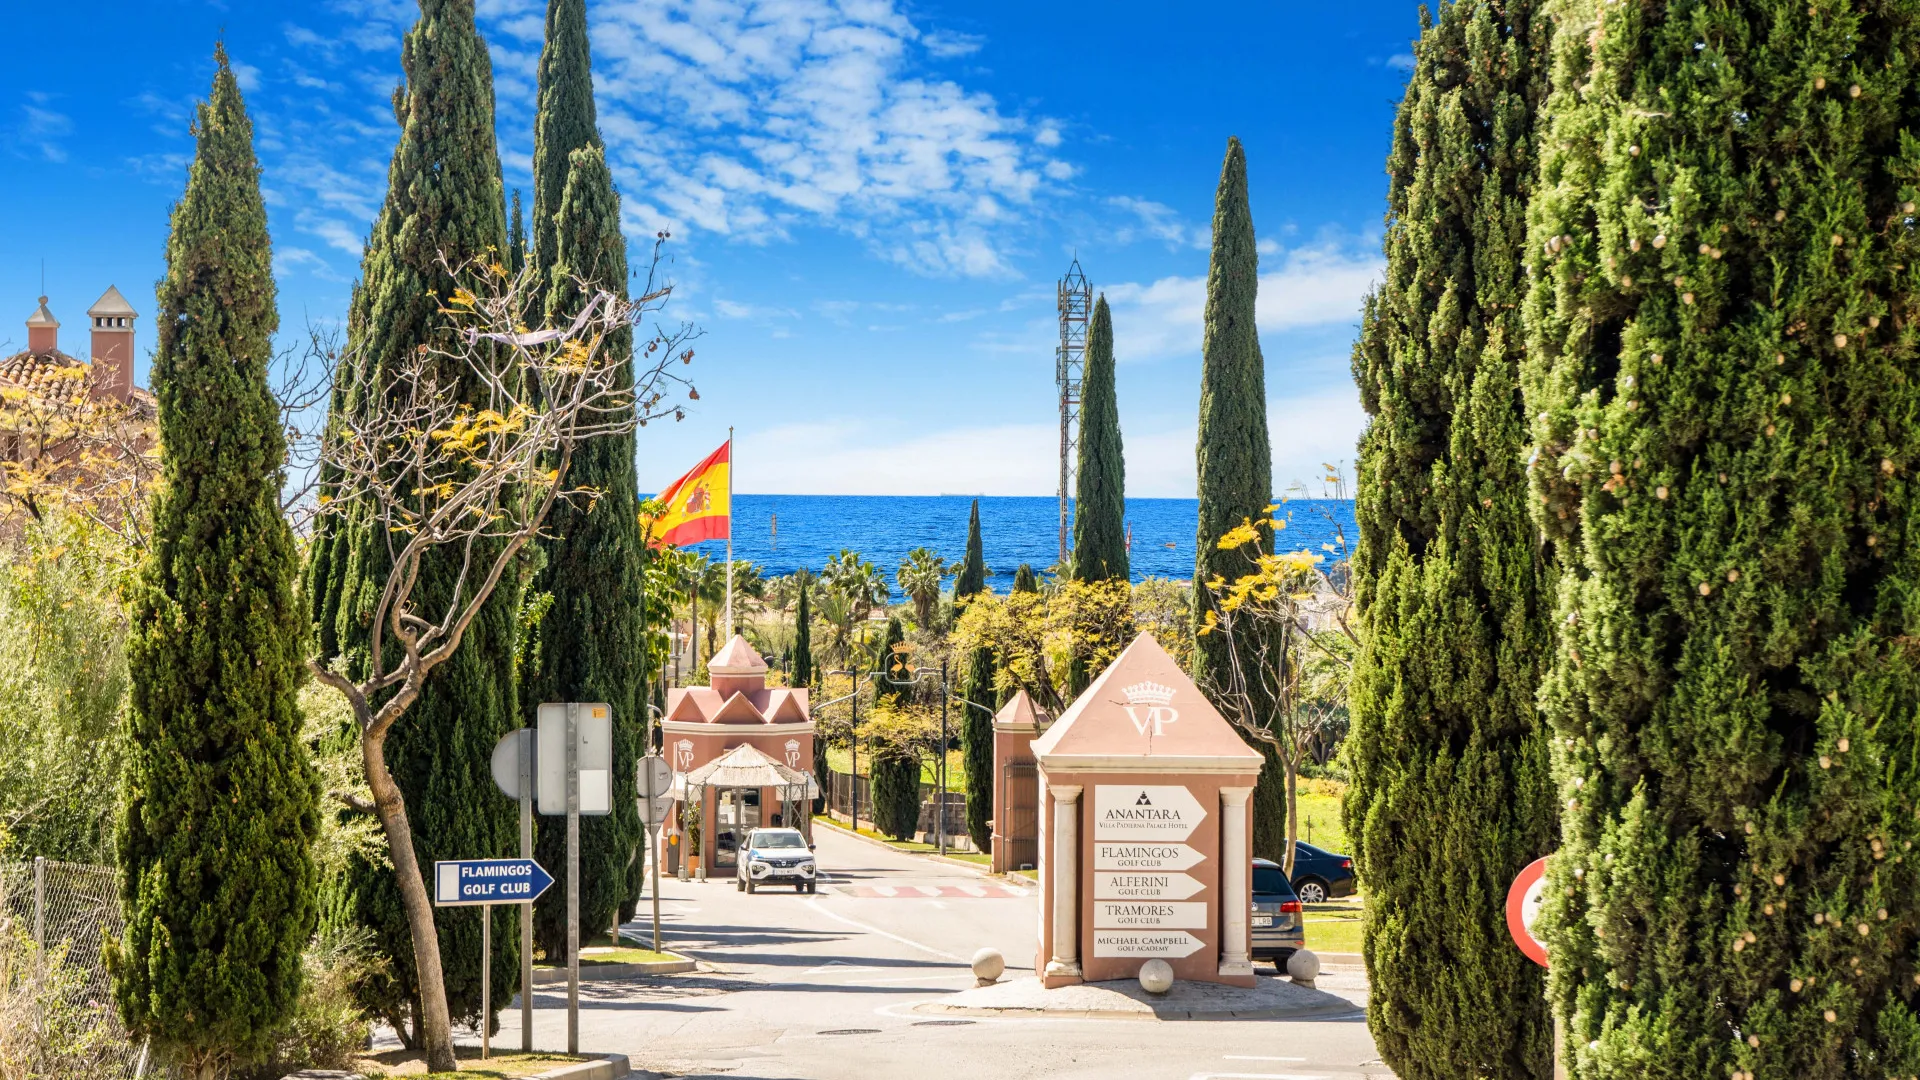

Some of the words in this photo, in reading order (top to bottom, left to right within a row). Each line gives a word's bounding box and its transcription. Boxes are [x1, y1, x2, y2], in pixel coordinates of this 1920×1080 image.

[1124, 706, 1179, 736] VP
[678, 751, 694, 768] VP
[785, 751, 801, 768] VP
[1105, 808, 1181, 820] ANANTARA
[1101, 847, 1179, 858] FLAMINGOS
[1117, 859, 1139, 867] GOLF
[1140, 859, 1162, 867] CLUB
[461, 864, 532, 878] FLAMINGOS
[1110, 876, 1168, 887] ALFERINI
[463, 883, 496, 895] GOLF
[500, 882, 531, 894] CLUB
[1140, 888, 1161, 896] CLUB
[1105, 905, 1174, 916] TRAMORES
[1097, 937, 1140, 945] MICHAEL
[1141, 937, 1189, 945] CAMPBELL
